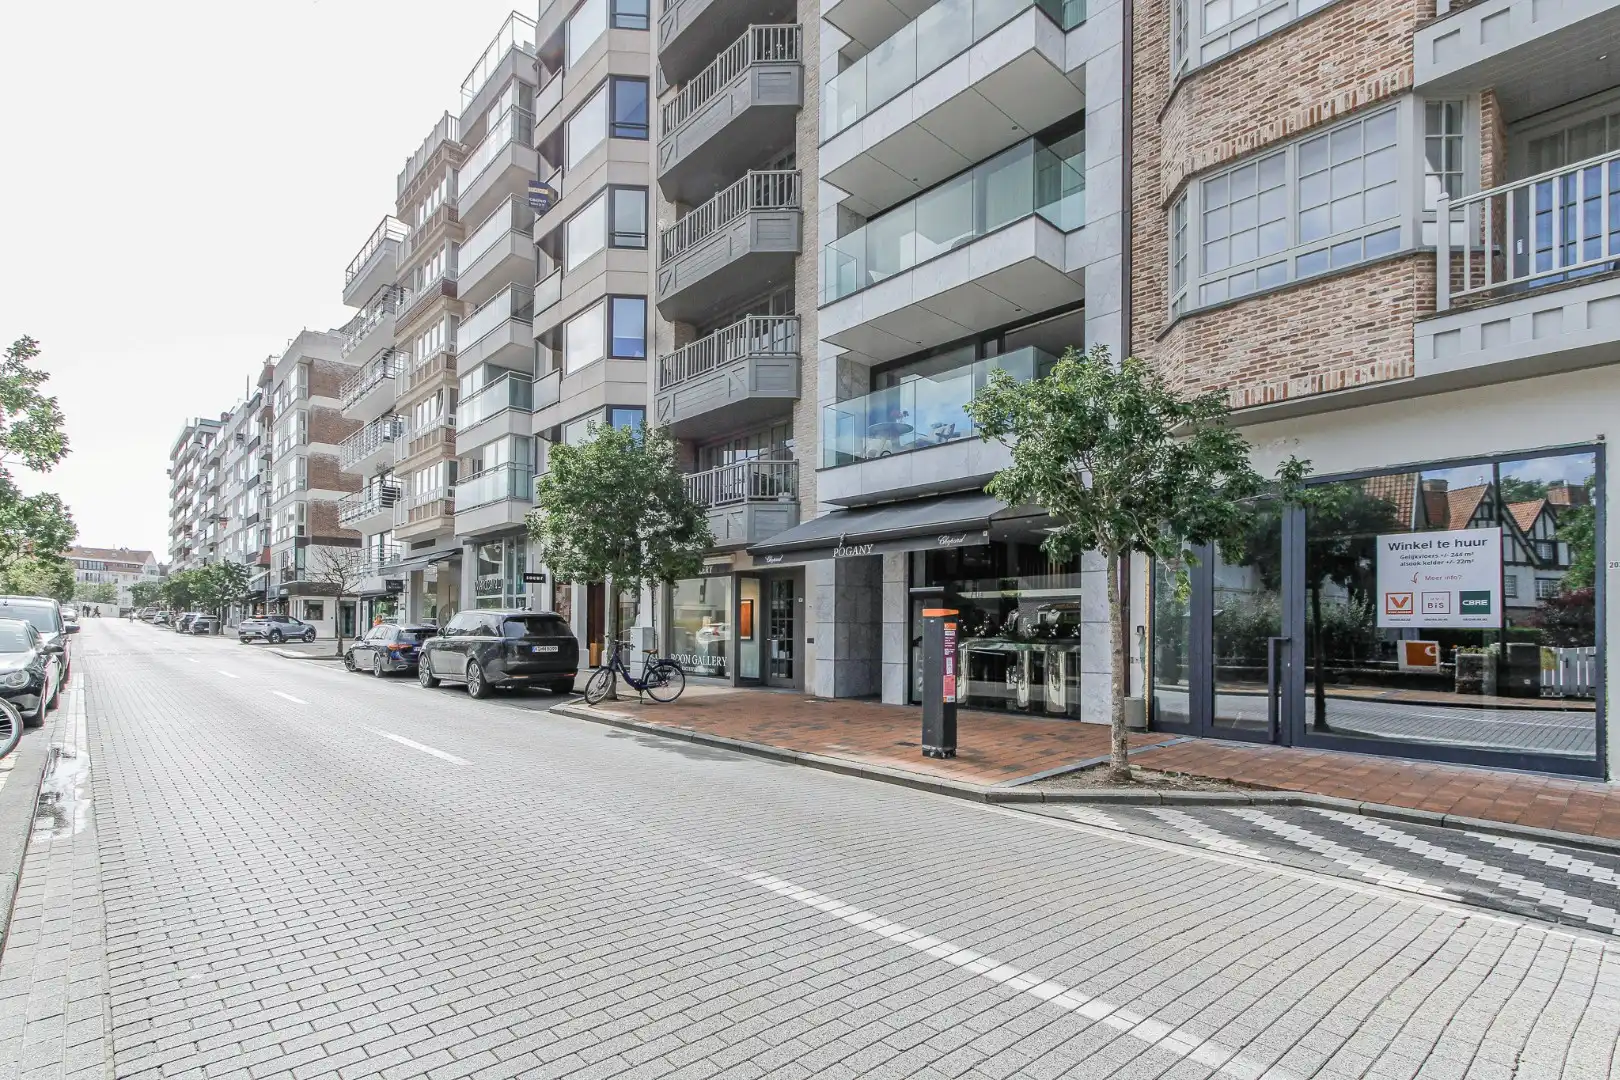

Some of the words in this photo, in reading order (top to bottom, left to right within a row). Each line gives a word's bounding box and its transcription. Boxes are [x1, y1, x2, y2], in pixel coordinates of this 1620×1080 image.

[832, 543, 874, 558] POGANY
[1388, 540, 1432, 551] Winkel
[1437, 539, 1450, 549] te
[1455, 538, 1488, 548] huur
[692, 654, 728, 667] GALLERY
